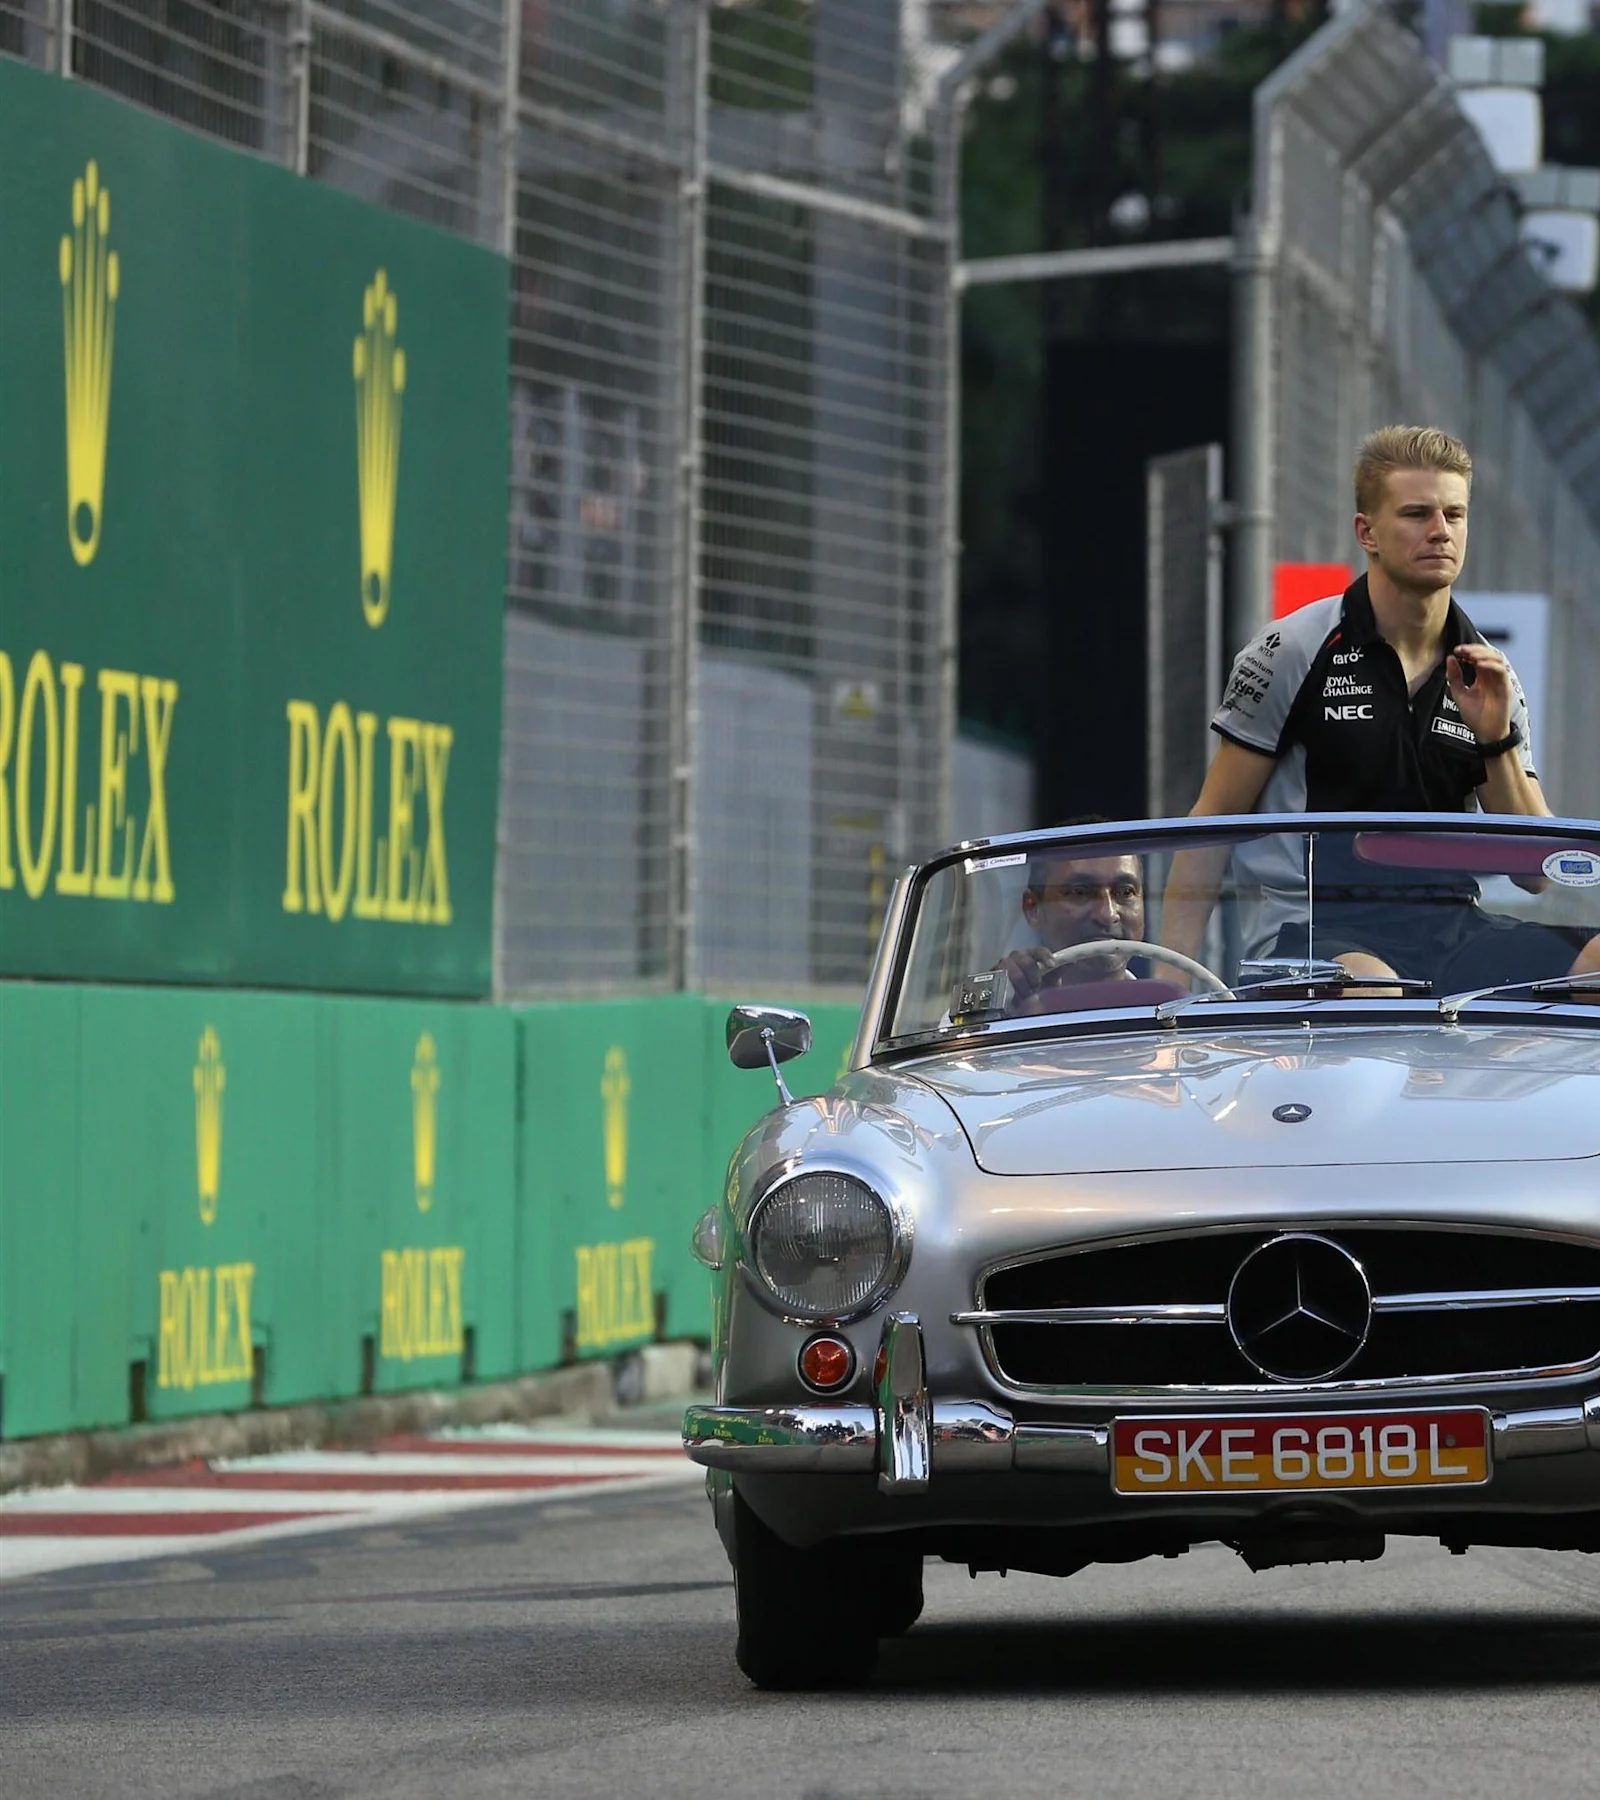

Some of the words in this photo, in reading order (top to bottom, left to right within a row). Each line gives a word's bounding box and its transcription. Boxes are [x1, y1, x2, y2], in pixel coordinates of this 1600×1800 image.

[1322, 685, 1373, 697] CHALLENGE
[1324, 704, 1374, 721] NEC
[1437, 721, 1475, 741] SMIRNOFF
[283, 700, 453, 923] ROLEX
[158, 1262, 256, 1390] ROLEX
[381, 1247, 464, 1361] ROLEX
[577, 1237, 656, 1347] ROLEX
[1134, 1429, 1260, 1483] SKE
[1272, 1424, 1418, 1481] 6818
[1430, 1423, 1469, 1476] L
